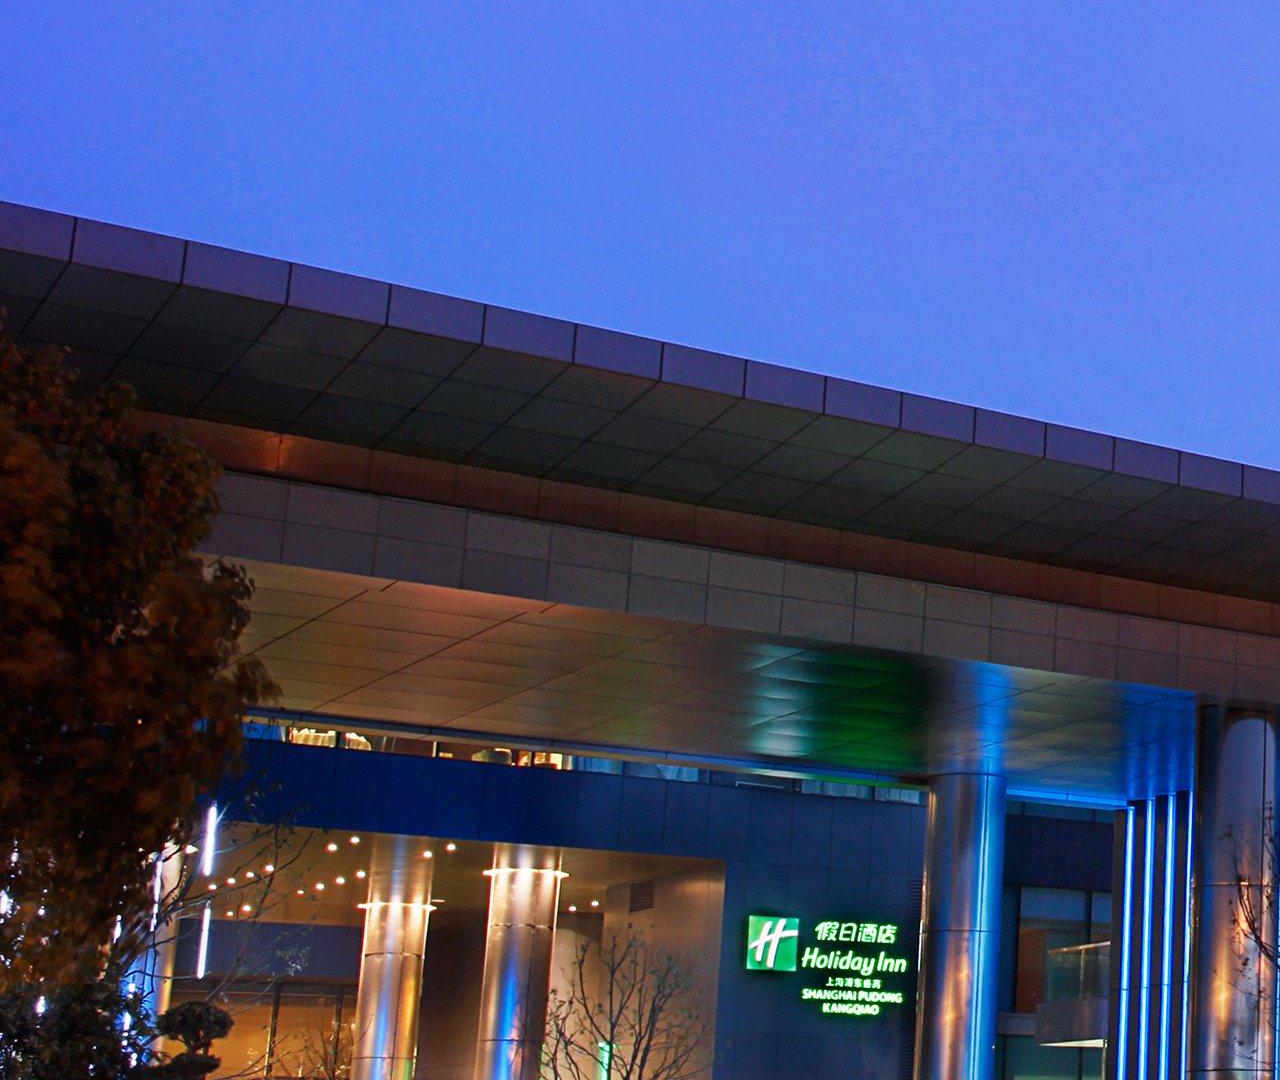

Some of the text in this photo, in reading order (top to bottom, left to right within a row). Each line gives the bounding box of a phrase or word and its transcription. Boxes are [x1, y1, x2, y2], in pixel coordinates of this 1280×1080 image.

[814, 921, 898, 944] 假日酒店
[801, 946, 907, 976] Holiday Inn
[801, 988, 903, 1004] SHANGHAI PUDONG
[822, 1002, 880, 1016] KANGQIAO
